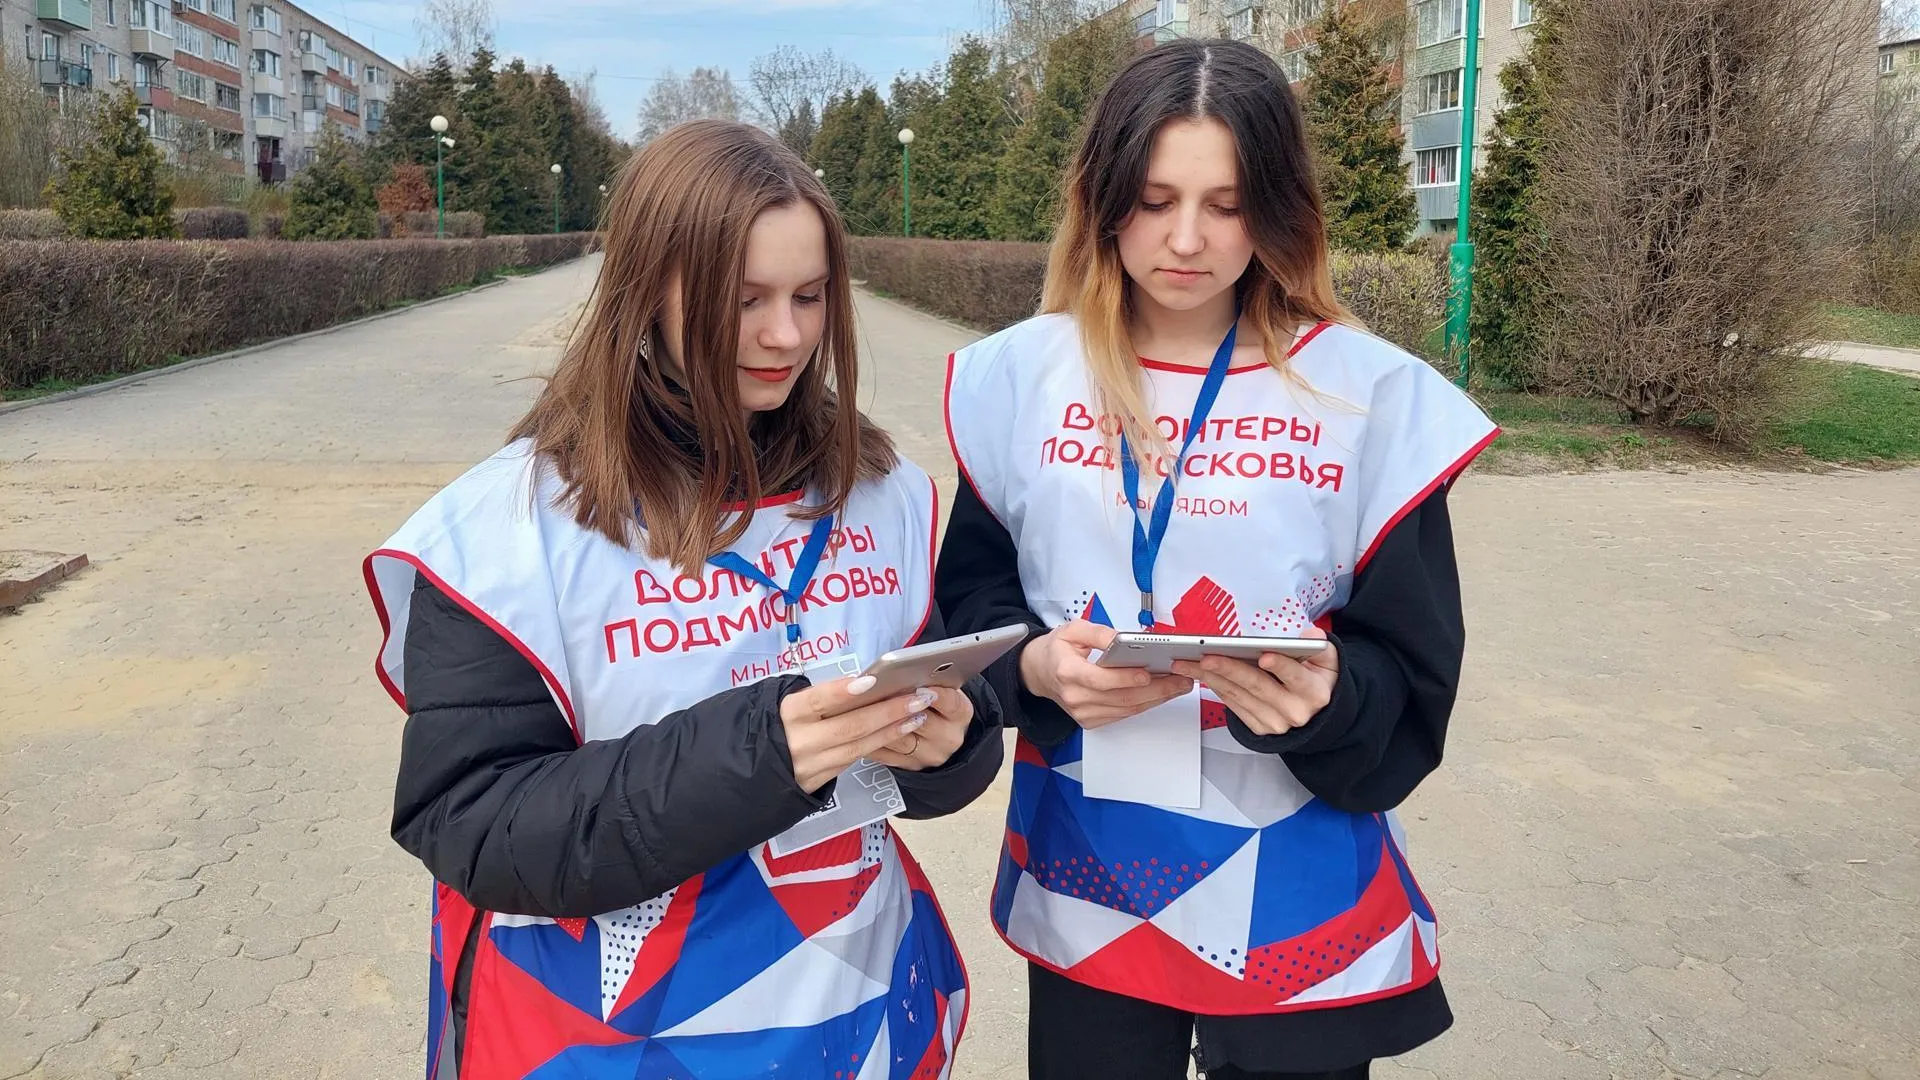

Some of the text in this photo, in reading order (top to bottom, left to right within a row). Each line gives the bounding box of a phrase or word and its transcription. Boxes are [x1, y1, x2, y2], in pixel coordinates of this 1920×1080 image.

[1062, 402, 1322, 447] ВООНТЕРЫ
[1040, 436, 1344, 493] ПОДОСКОВЬЯ
[1171, 497, 1248, 517] ЯДОМ
[635, 524, 877, 606] ВОЛОНТРЫ
[604, 566, 902, 663] ПОДМОСКОВЬЯ
[731, 659, 770, 687] МЫ
